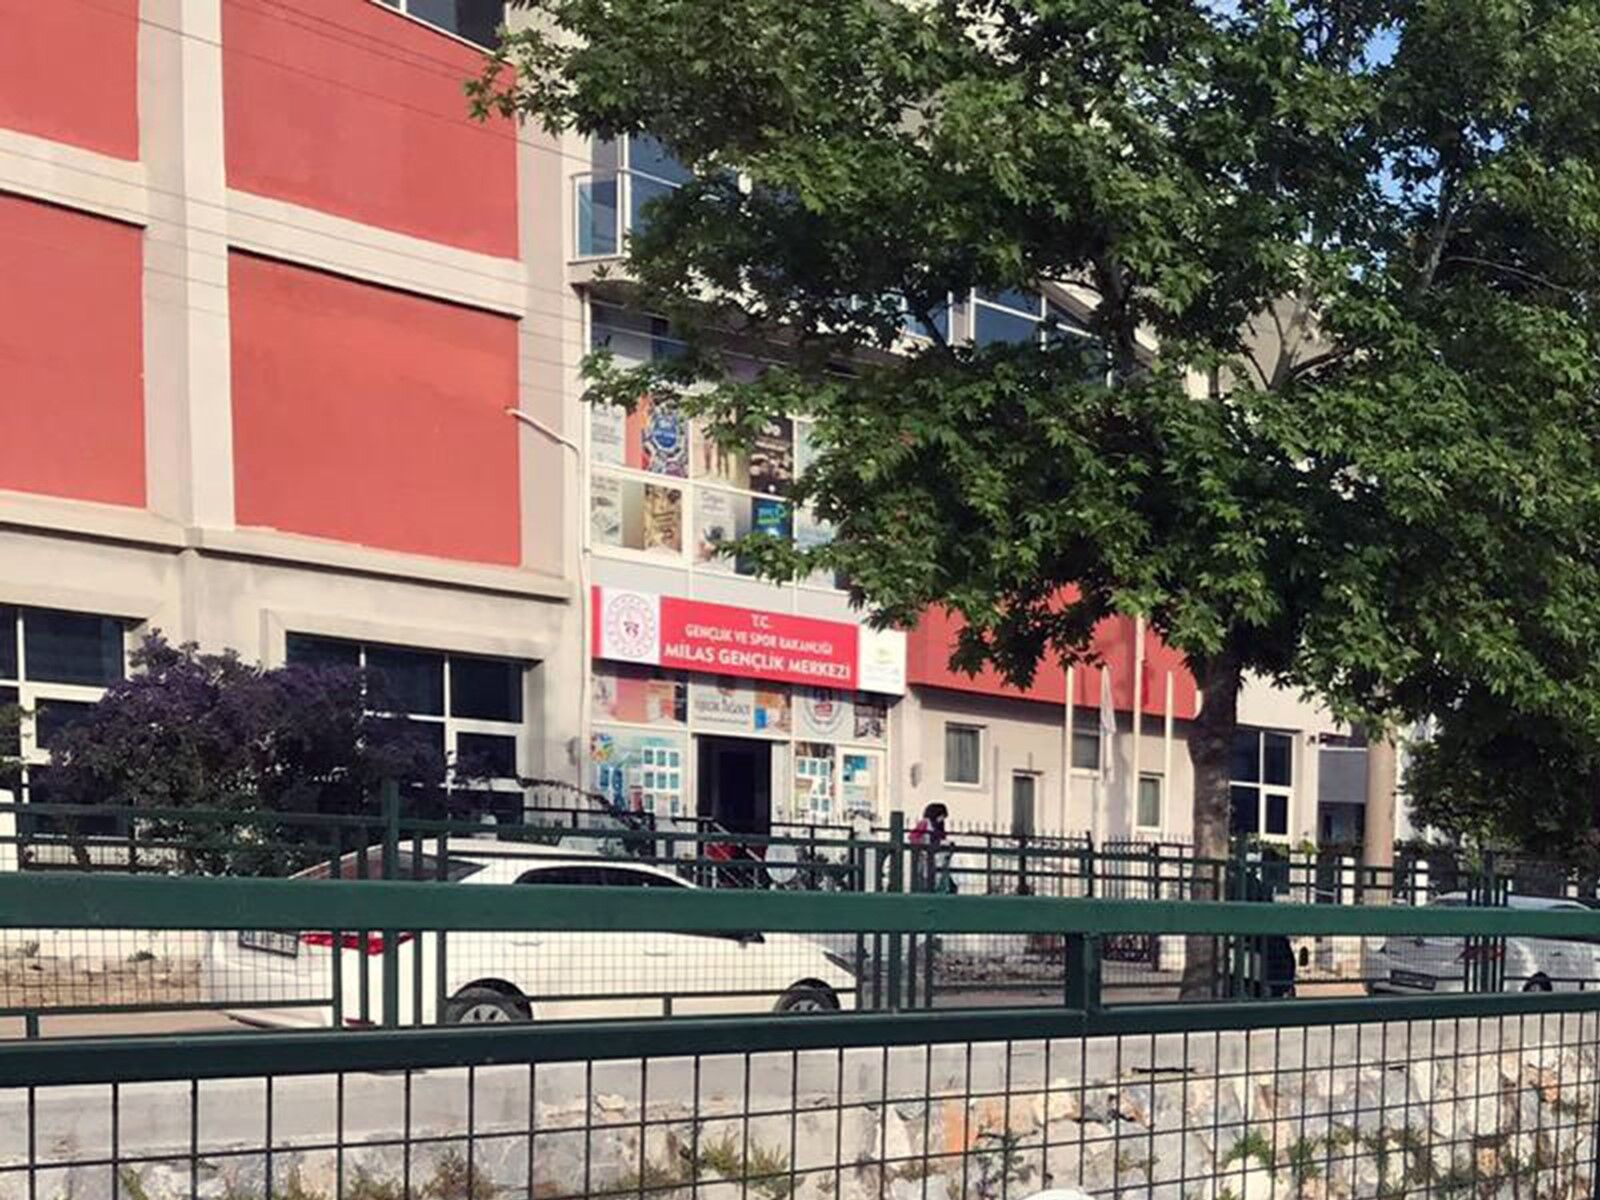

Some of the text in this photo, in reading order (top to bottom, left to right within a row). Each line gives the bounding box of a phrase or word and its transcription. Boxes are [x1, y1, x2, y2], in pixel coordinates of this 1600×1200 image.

[735, 630, 748, 644] VE
[749, 631, 777, 648] SPOR
[664, 641, 715, 663] MİLAS
[718, 649, 786, 672] GENÇLİK
[788, 657, 851, 680] MERKEZİ
